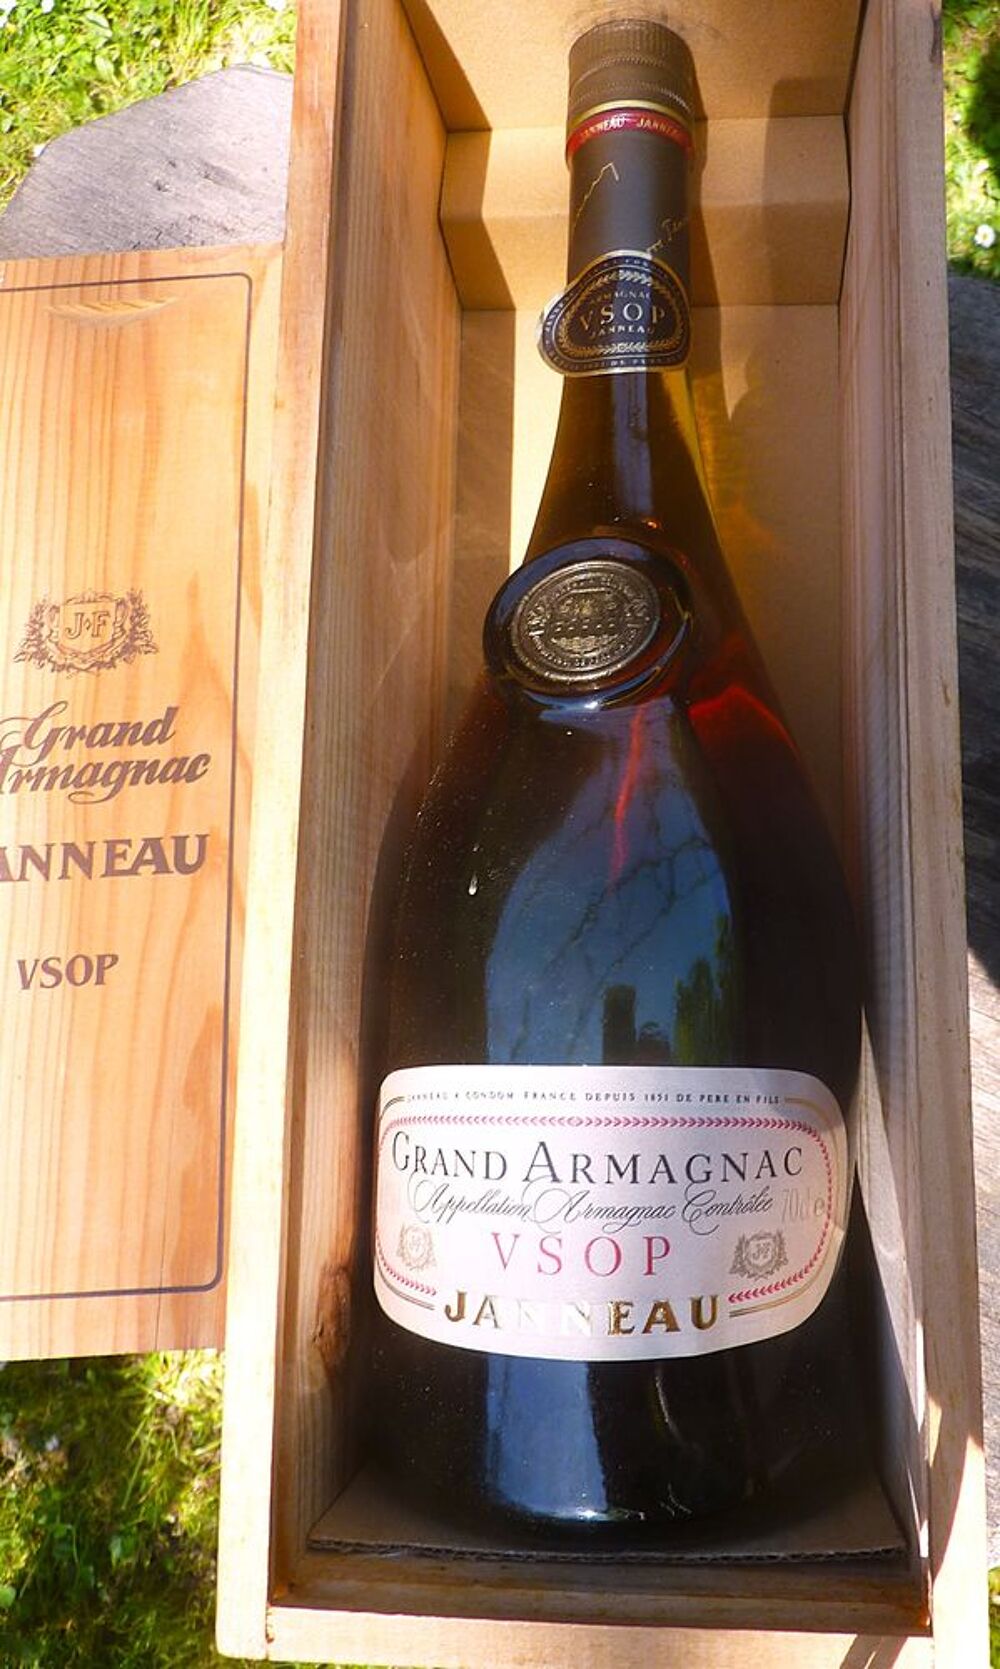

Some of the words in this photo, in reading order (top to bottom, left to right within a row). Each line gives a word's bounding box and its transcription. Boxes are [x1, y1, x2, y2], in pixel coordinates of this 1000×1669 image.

[580, 302, 666, 331] VSOP
[0, 700, 180, 767] Grand
[17, 953, 119, 990] VSOP
[465, 1090, 514, 1100] CONDOM
[523, 1091, 577, 1101] FRANCE
[585, 1092, 635, 1101] DEPUIS
[676, 1094, 692, 1102] DE
[699, 1094, 729, 1103] PERE
[736, 1095, 750, 1103] EN
[756, 1095, 780, 1104] FILS
[392, 1130, 508, 1181] GRAND
[522, 1141, 802, 1184] ARMAGNAC
[407, 1178, 532, 1224] Appellation
[521, 1175, 677, 1234] Armagnac
[491, 1231, 671, 1278] VSOP
[444, 1290, 719, 1336] JANNEAU
